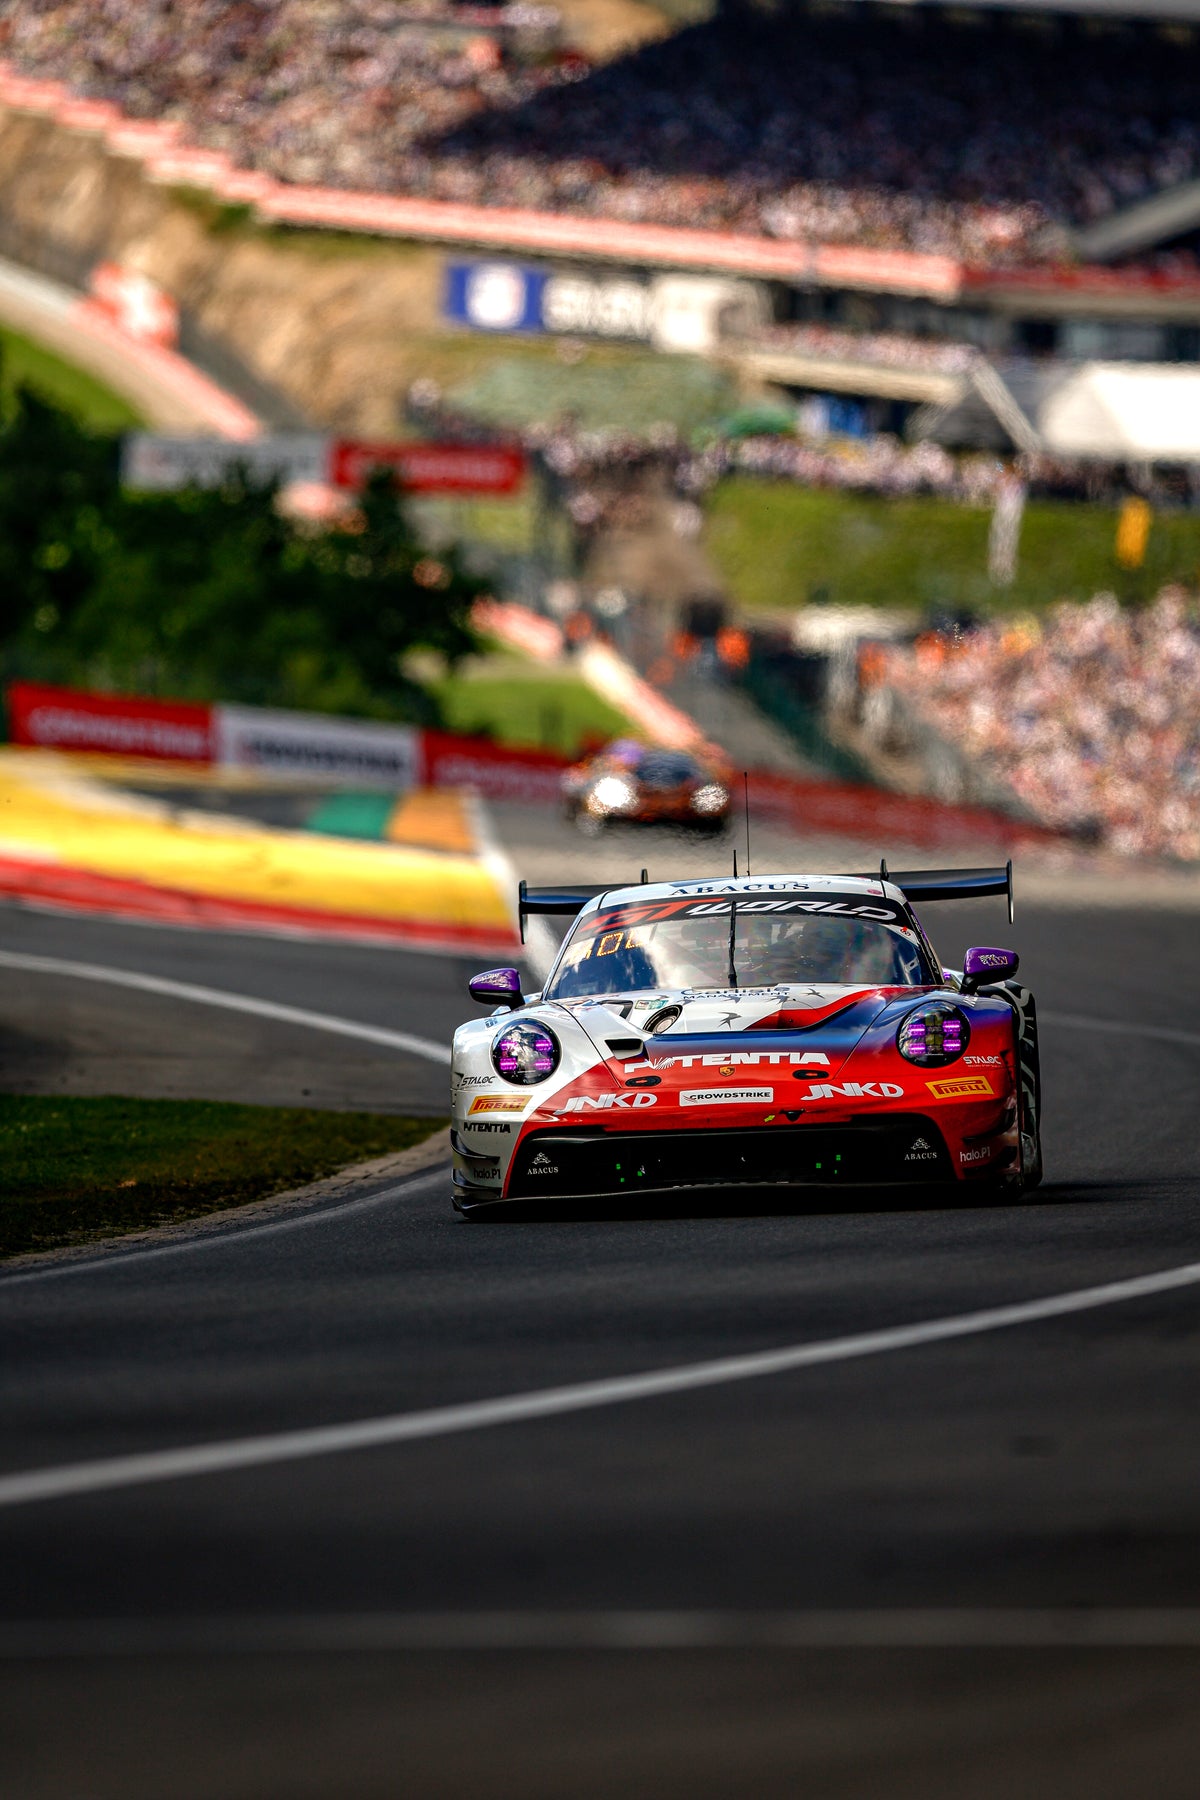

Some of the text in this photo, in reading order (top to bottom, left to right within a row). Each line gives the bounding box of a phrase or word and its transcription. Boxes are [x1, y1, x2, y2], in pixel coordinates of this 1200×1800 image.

[671, 884, 810, 896] ABACUS
[686, 900, 897, 921] WORLD
[963, 1055, 1002, 1065] STALOC
[461, 1076, 496, 1086] STALOC
[933, 1079, 988, 1095] PIRELLI
[690, 1091, 771, 1101] CROWDSTRIKE
[800, 1082, 904, 1101] JNKD
[473, 1097, 525, 1111] PIRELLI
[552, 1092, 658, 1115] JNKD
[904, 1152, 938, 1161] ABACUS
[527, 1166, 559, 1176] ABACUS
